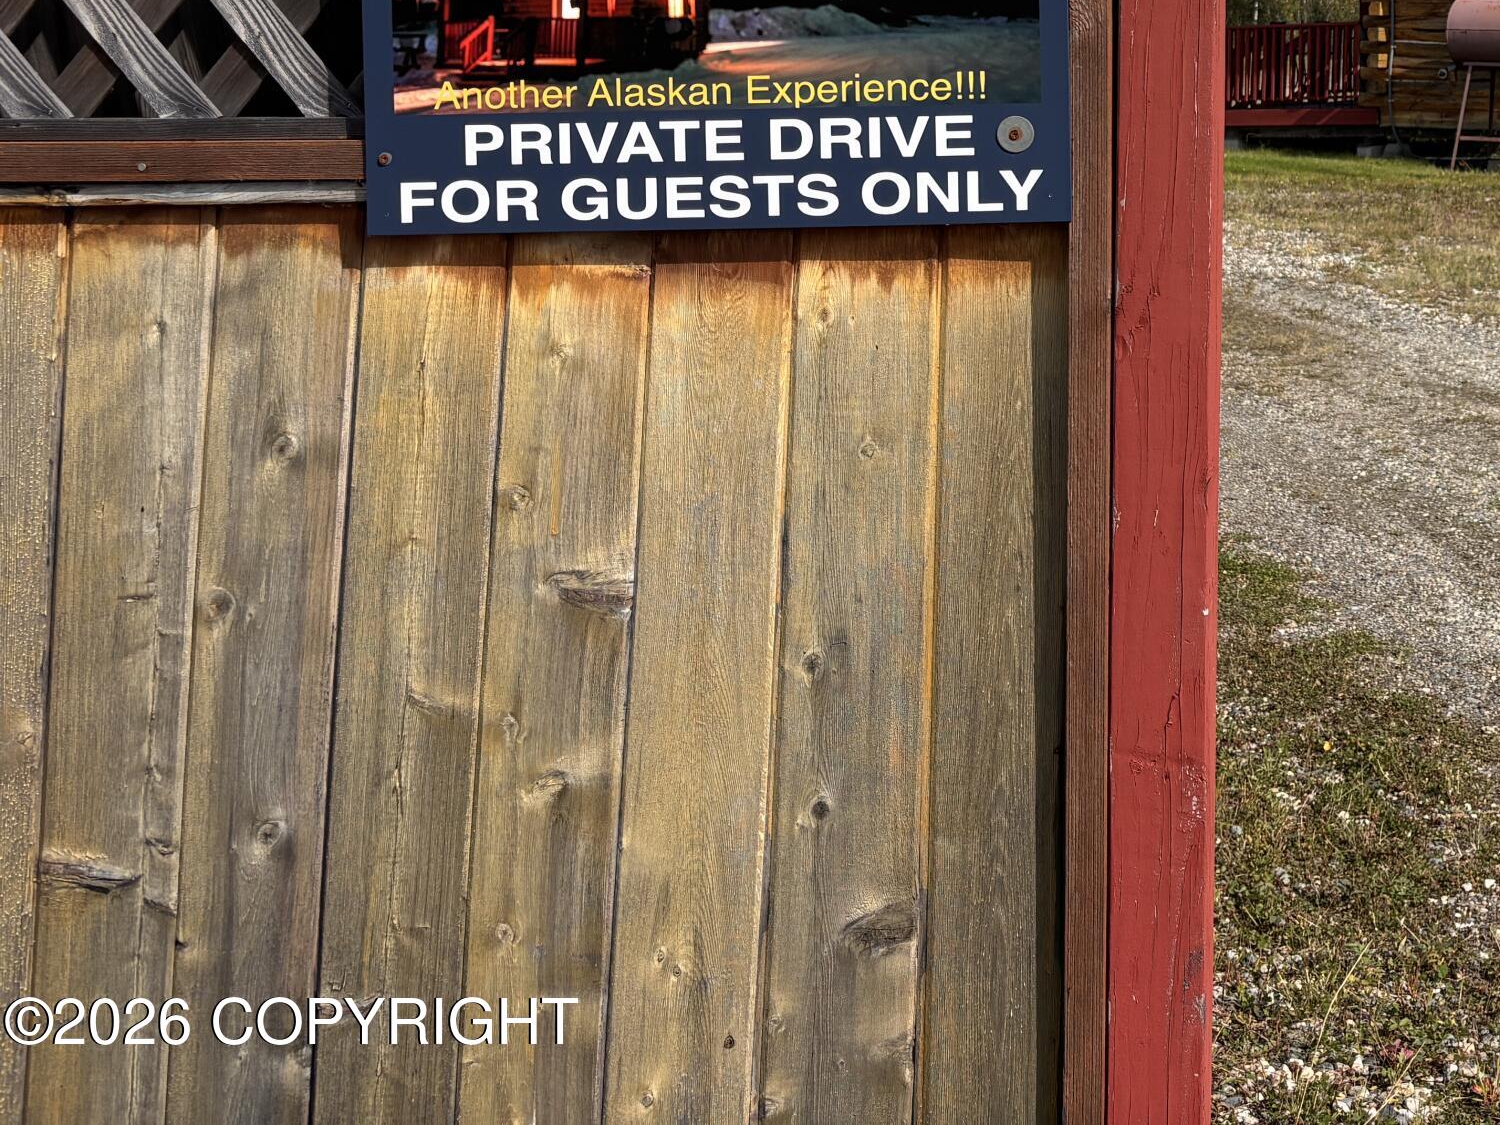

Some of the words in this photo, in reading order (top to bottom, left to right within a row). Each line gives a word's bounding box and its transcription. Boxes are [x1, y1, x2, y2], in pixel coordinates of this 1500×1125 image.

[433, 79, 578, 110] Another
[587, 77, 732, 108] Alaskan
[747, 70, 987, 108] Experience!!!
[464, 119, 745, 166] PRIVATE
[769, 114, 976, 161] DRIVE
[400, 179, 540, 224] FOR
[561, 173, 840, 221] GUESTS
[861, 169, 1044, 215] ONLY
